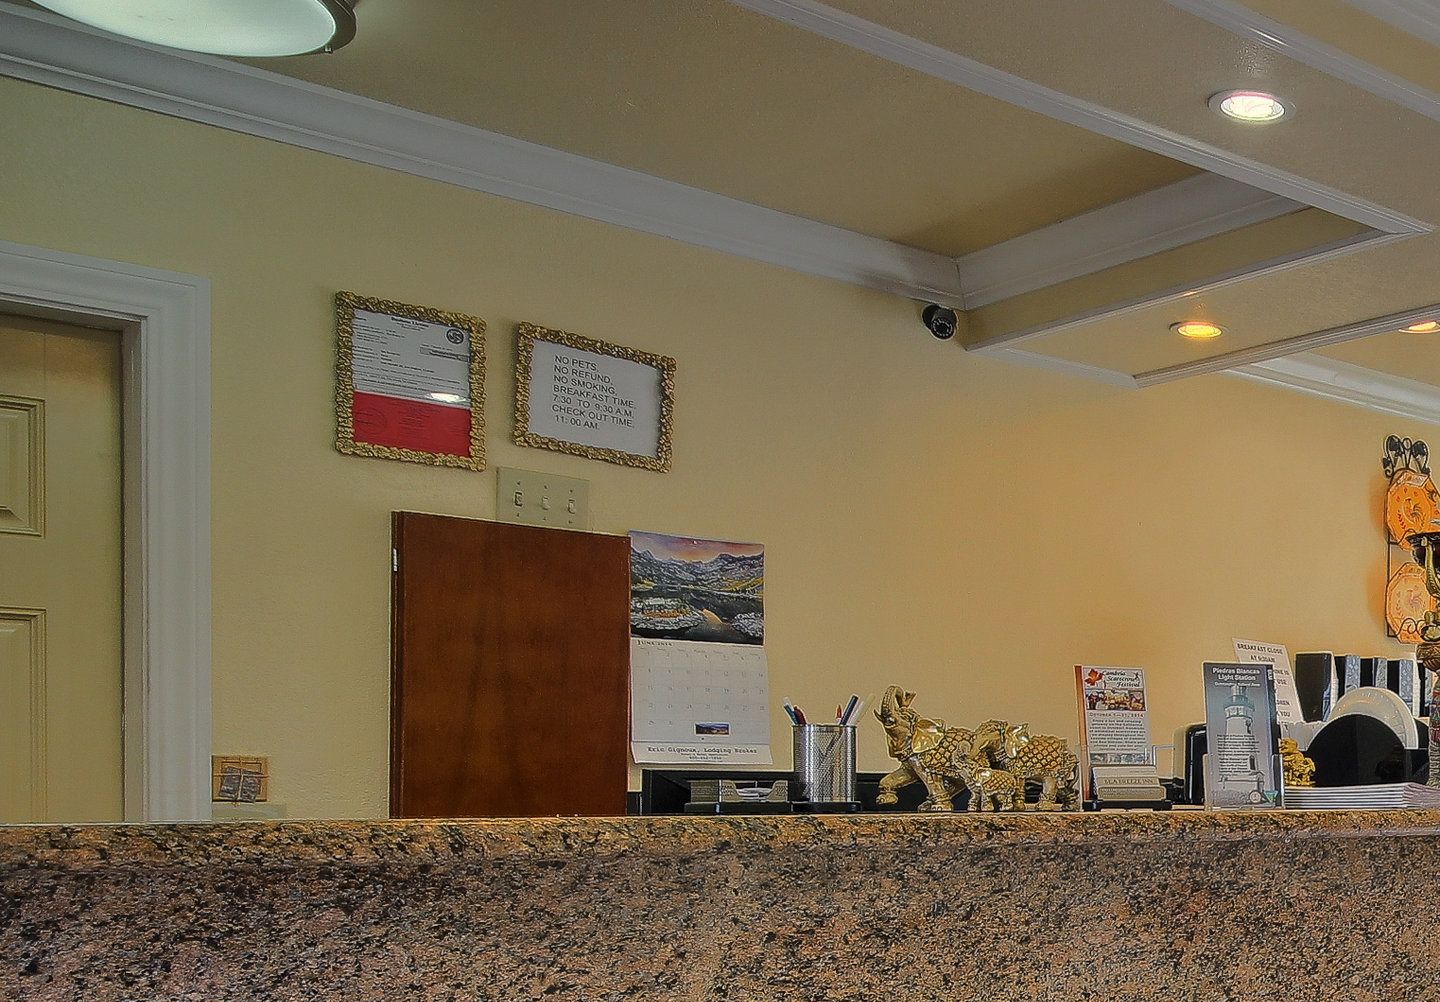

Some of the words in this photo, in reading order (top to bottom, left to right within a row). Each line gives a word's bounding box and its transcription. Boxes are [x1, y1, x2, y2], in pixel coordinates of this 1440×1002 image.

[554, 355, 569, 364] NO
[572, 359, 599, 372] PETS.
[554, 364, 569, 374] NO
[572, 369, 613, 385] REFUND.
[554, 374, 568, 384] NO
[553, 385, 610, 403] BREAKFAST
[553, 394, 572, 404] 7:30
[578, 400, 590, 408] TO
[595, 404, 613, 413] 9:30
[552, 404, 586, 417] CHECK
[589, 412, 608, 421] OUT
[570, 418, 581, 426] 00
